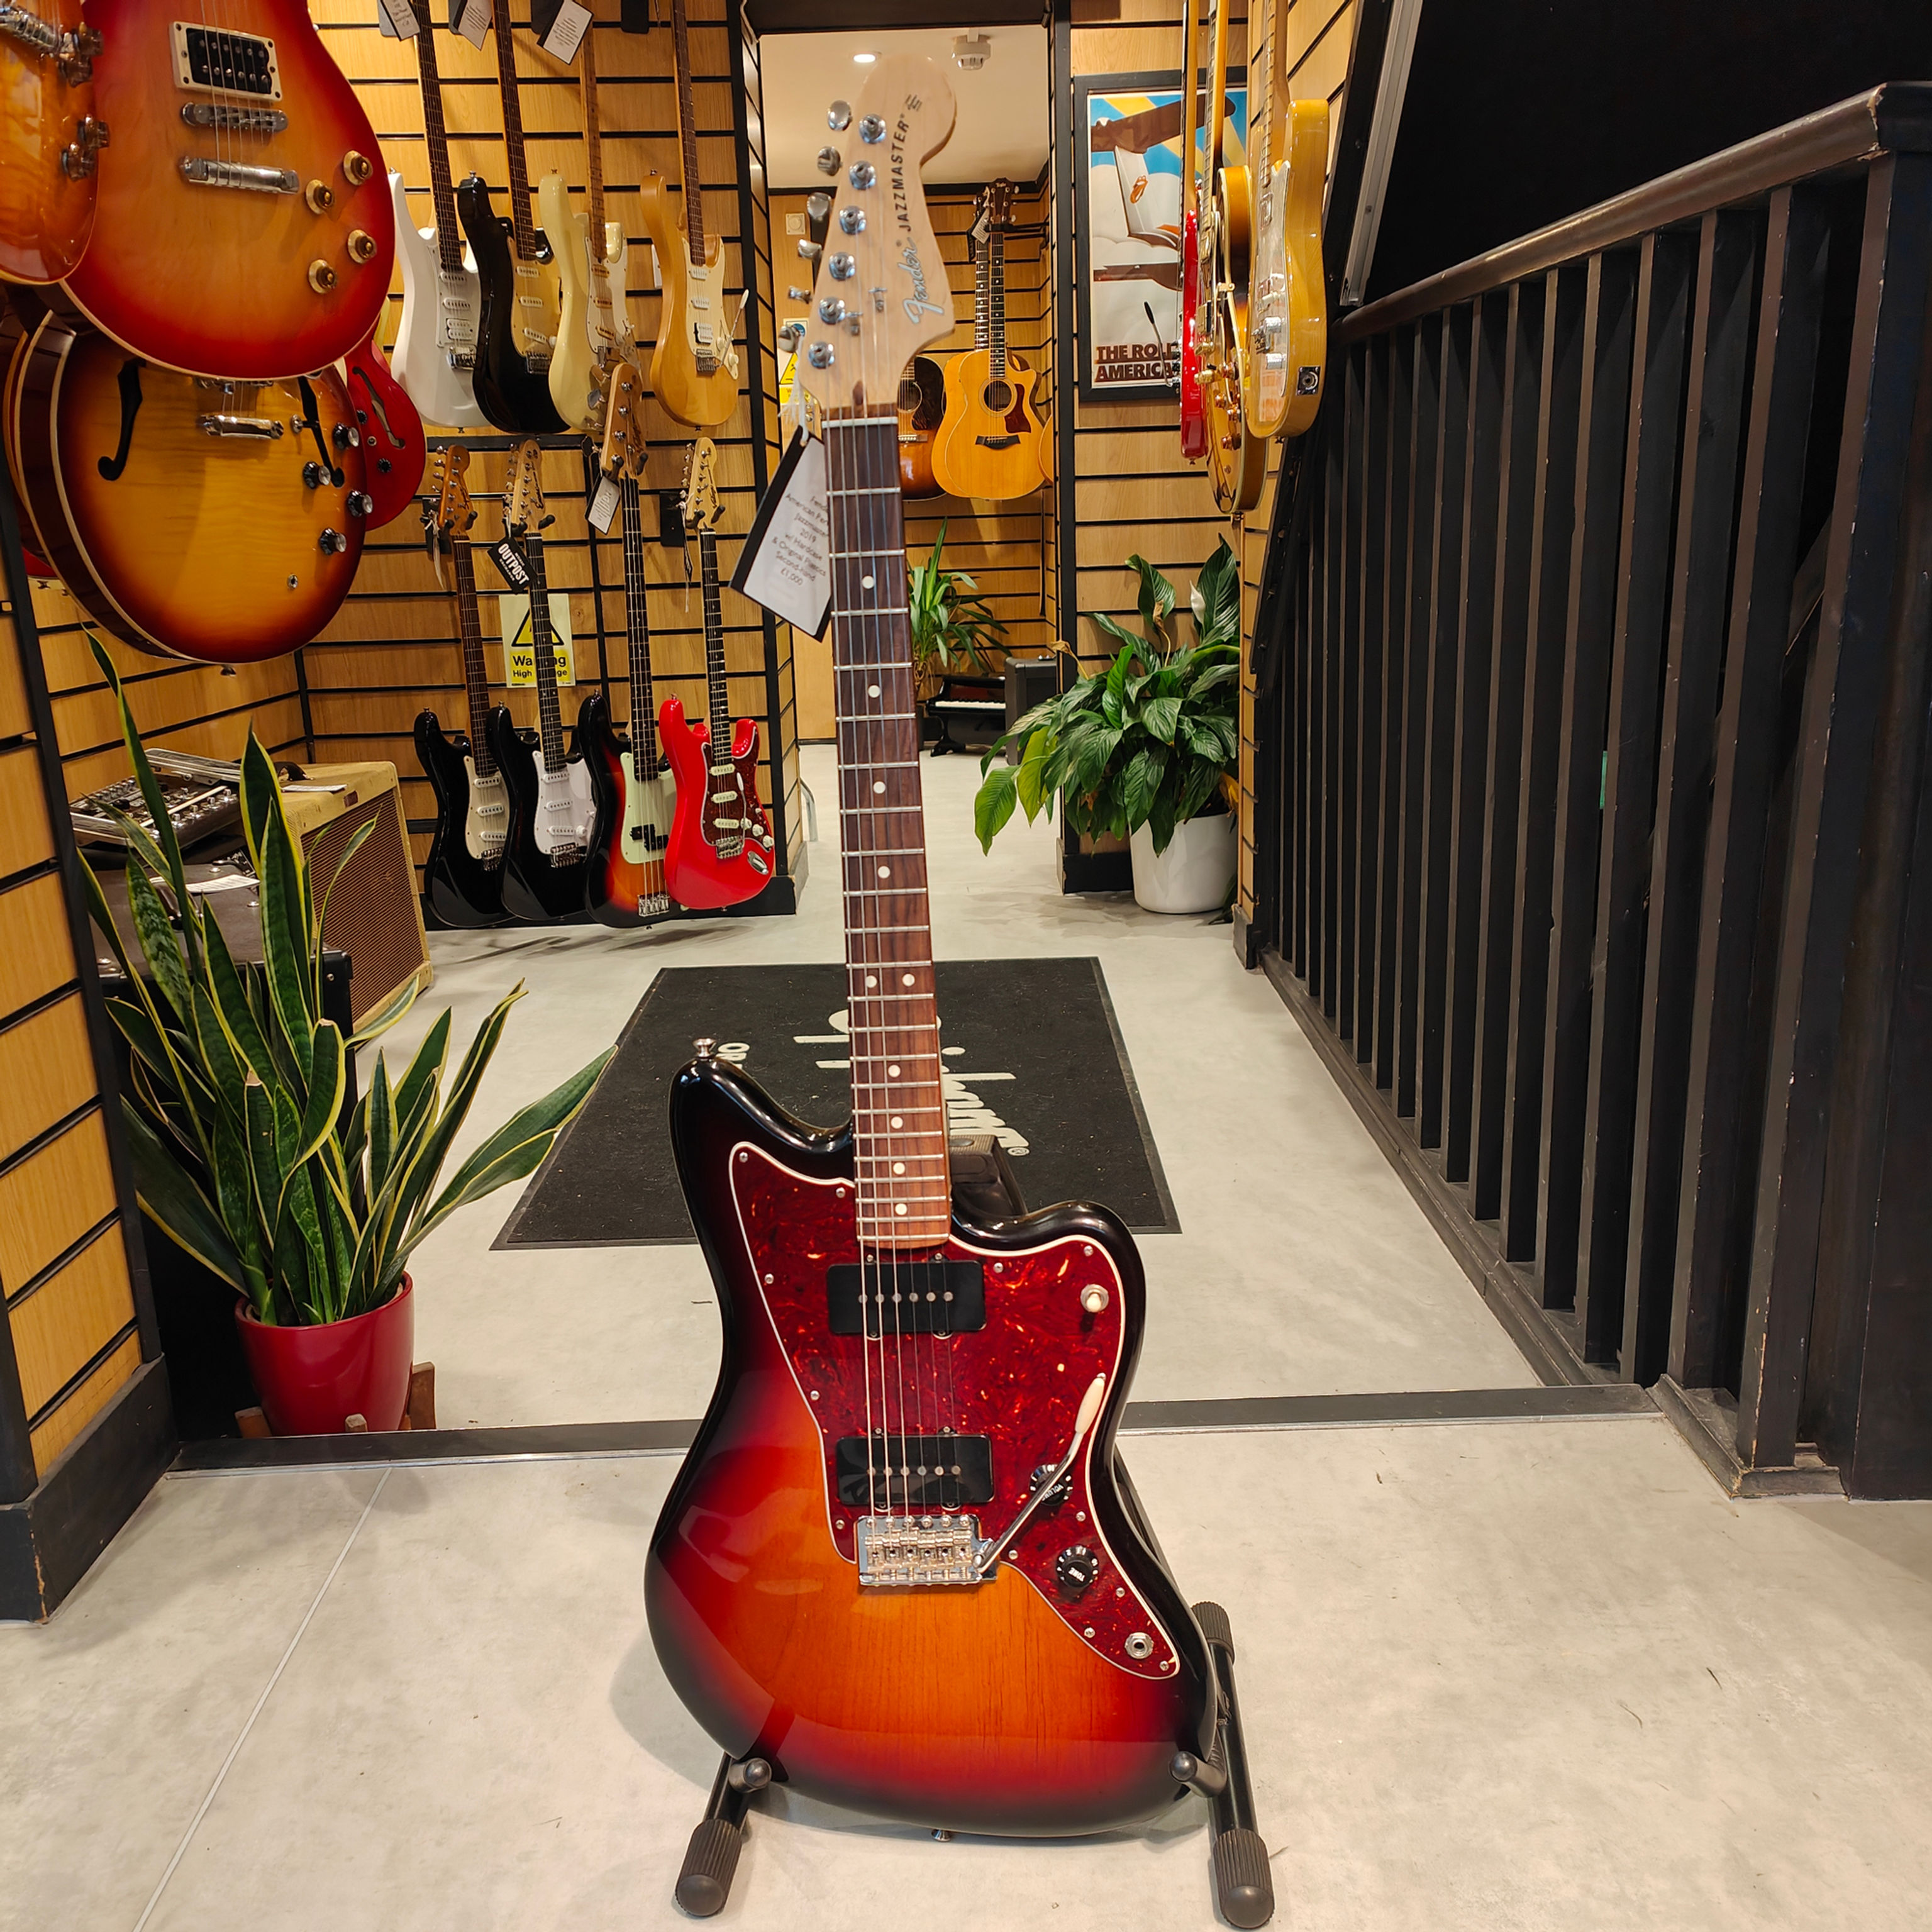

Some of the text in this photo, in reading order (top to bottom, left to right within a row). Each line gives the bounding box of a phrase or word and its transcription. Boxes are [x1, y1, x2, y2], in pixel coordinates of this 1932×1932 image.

[891, 119, 912, 233] JAZZMASTER
[897, 236, 944, 325] Fender
[1096, 343, 1172, 362] THE ROLL
[1095, 362, 1174, 382] AMERICA
[786, 493, 815, 517] American
[800, 528, 816, 543] 2019
[497, 543, 530, 585] OUTPOST
[513, 670, 533, 679] High
[1068, 1567, 1085, 1582] TONE
